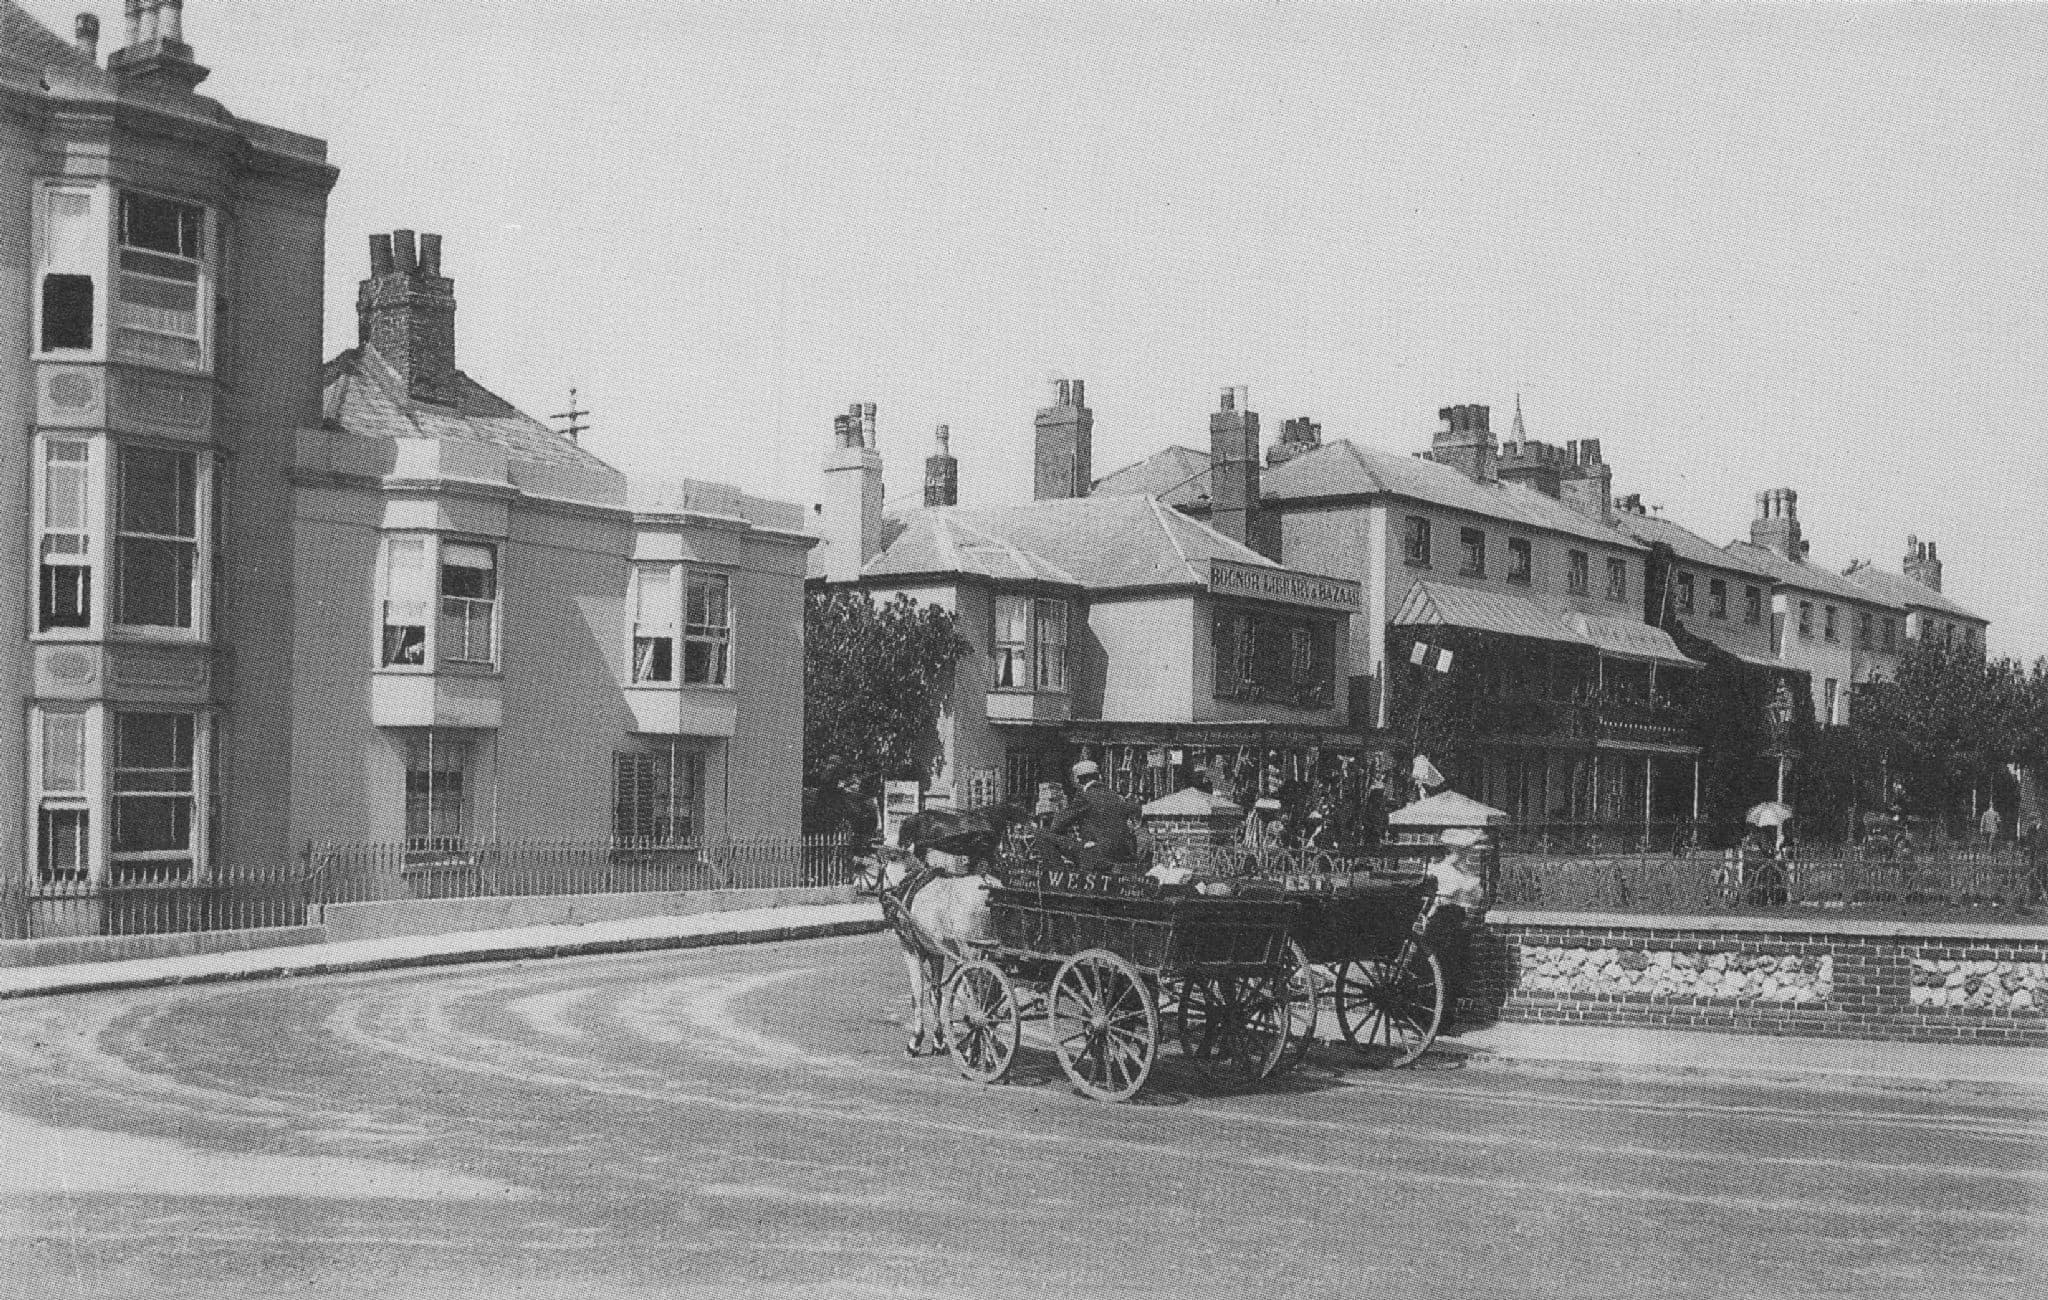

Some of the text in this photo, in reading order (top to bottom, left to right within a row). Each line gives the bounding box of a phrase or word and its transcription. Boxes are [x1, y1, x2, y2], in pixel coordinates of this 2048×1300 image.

[1211, 566, 1259, 591] BOGNOR
[1263, 574, 1308, 599] LIBRARY
[1318, 583, 1361, 606] BAZAAR
[1048, 870, 1112, 892] WEST
